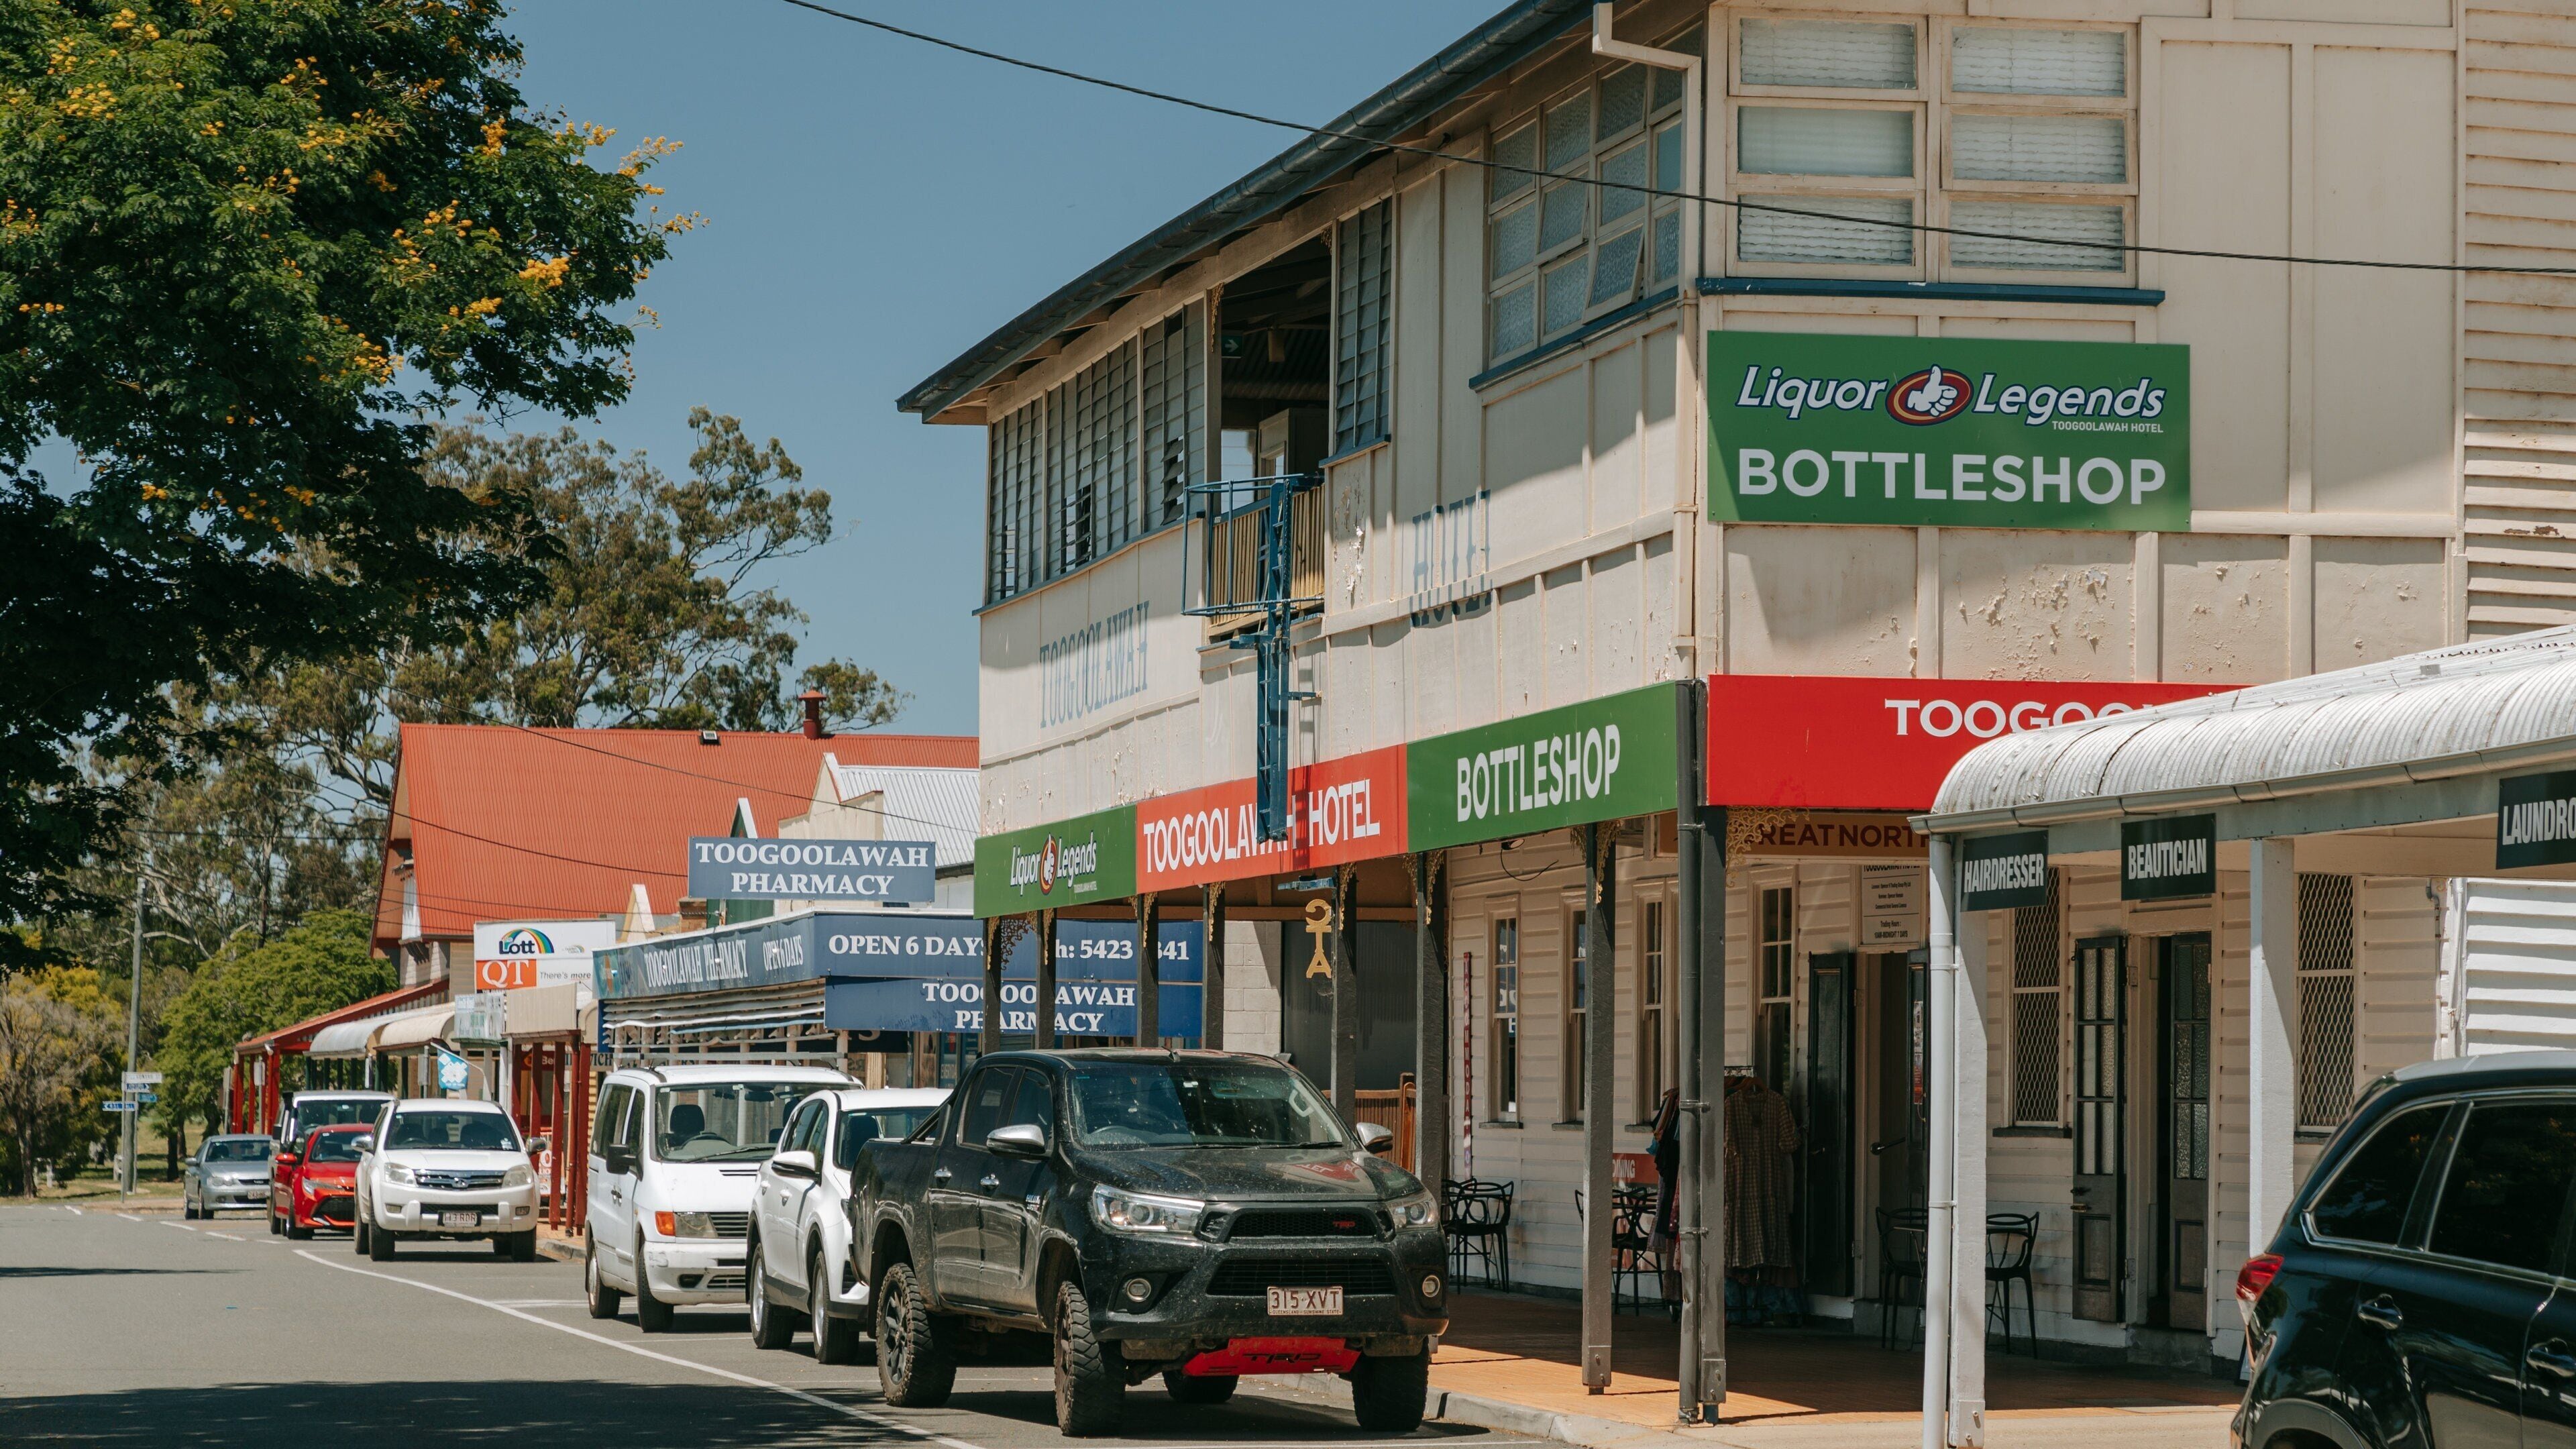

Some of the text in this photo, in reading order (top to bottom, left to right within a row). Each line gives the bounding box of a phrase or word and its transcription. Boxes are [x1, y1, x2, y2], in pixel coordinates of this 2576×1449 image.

[1736, 365, 2166, 425] Liquor Legends
[2052, 421, 2163, 433] TOOGOOLAWAH HOTEL
[1739, 449, 2165, 504] BOTTLESHOP
[1040, 600, 1149, 729] TOOGOOLAWAH
[1458, 724, 1620, 822] BOTTLESHOP
[1144, 779, 1380, 873] TOOGOOLAWH HOTEL
[1746, 824, 1835, 847] REAT
[696, 843, 928, 867] TOOGOOLAWAH
[1010, 830, 1097, 896] Liquor Legends
[1964, 853, 2044, 894] HAIRDRESSER
[2129, 838, 2207, 880] BEAUTICIAN
[731, 872, 894, 896] PHARMACY
[499, 941, 535, 955] Lott
[644, 945, 703, 987] TOOGOOLAWAH
[704, 939, 748, 981] PHARMACY
[784, 935, 803, 967] DAYS
[828, 934, 899, 956] OPEN
[906, 936, 917, 956] 6
[1081, 940, 1133, 959] 5423
[482, 960, 529, 987] QT
[922, 983, 1135, 1006] TOOOOAWAH
